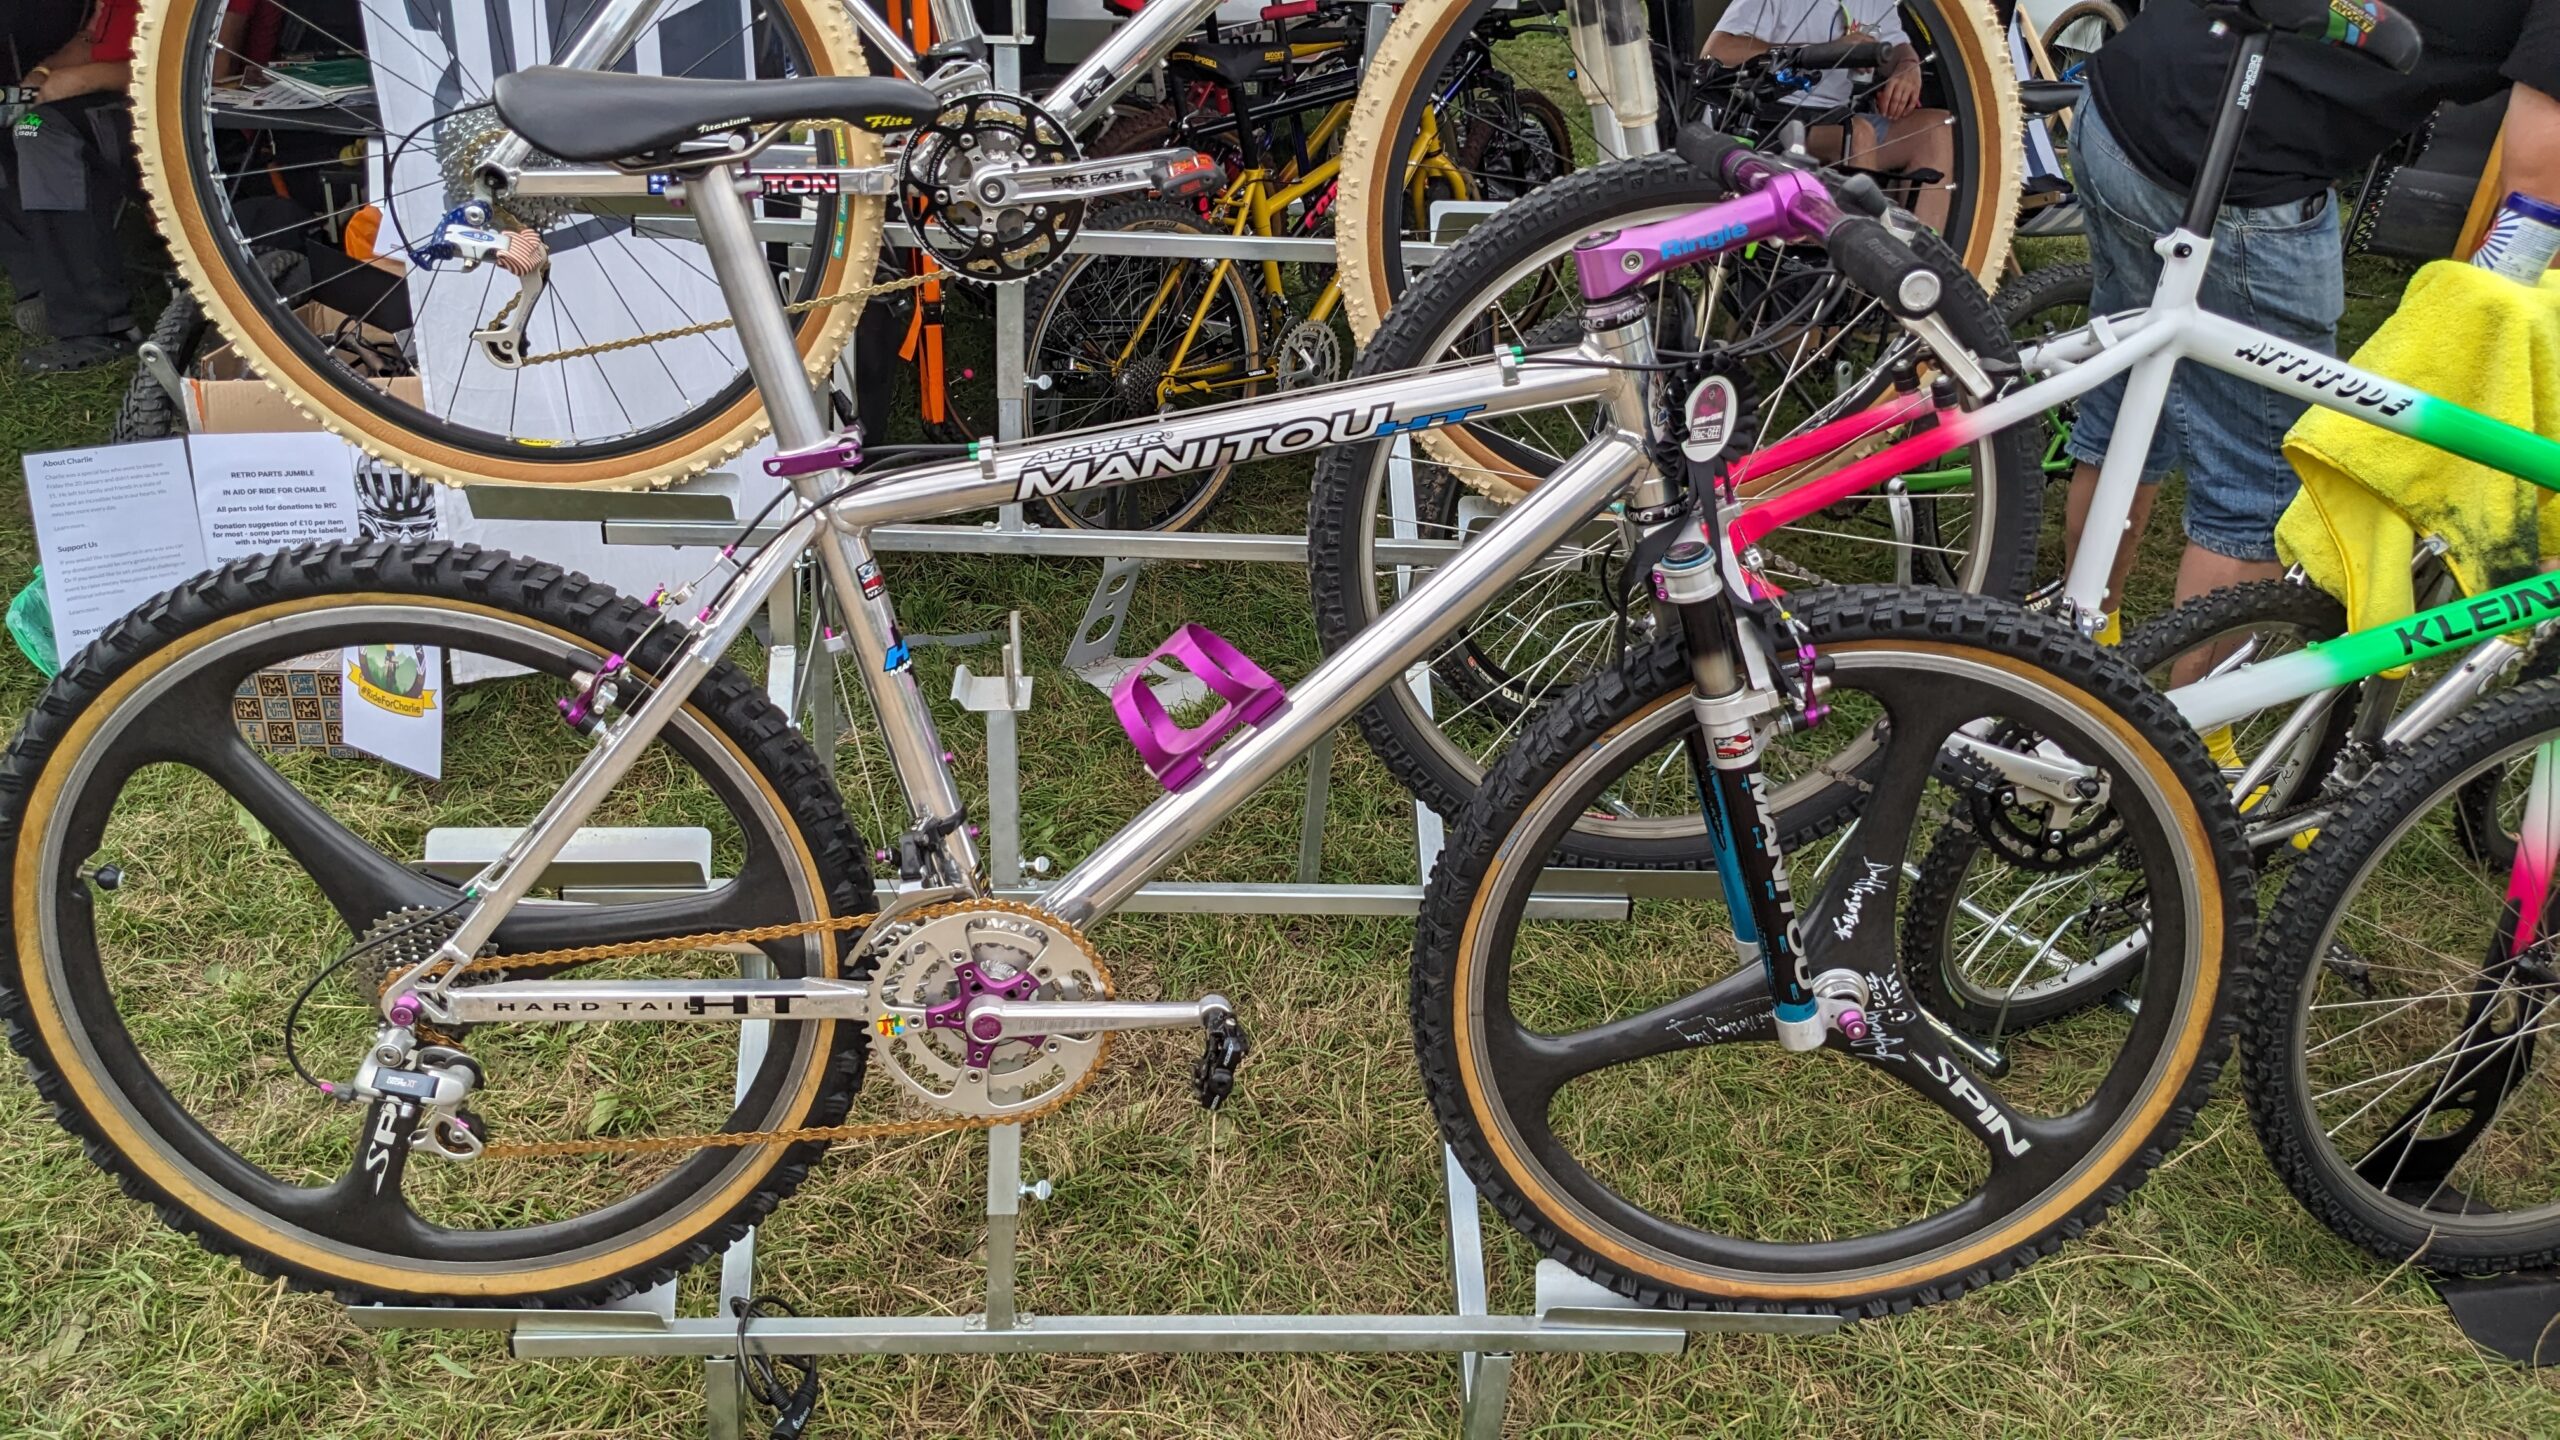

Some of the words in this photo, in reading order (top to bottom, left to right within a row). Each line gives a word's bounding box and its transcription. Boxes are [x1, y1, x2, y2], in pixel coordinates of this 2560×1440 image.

[698, 117, 751, 133] Titanium
[864, 115, 913, 129] Flite
[1051, 174, 1087, 185] RACE
[1090, 170, 1123, 182] FACE
[1580, 318, 1604, 328] KING
[1617, 304, 1646, 324] KING
[2234, 341, 2413, 416] ATTITUDE
[1015, 401, 1393, 501] MANITOU
[43, 456, 65, 467] About
[66, 456, 93, 465] Charlie
[1628, 511, 1653, 521] KING
[248, 521, 288, 529] suggestion
[57, 542, 86, 553] Support
[87, 541, 98, 549] Us
[2394, 579, 2560, 656] KLEIN
[72, 628, 91, 636] Shop
[497, 1002, 601, 1012] HARD
[617, 1001, 699, 1011] TAIL
[689, 994, 808, 1015] HT
[1908, 1049, 2032, 1158] SPIN
